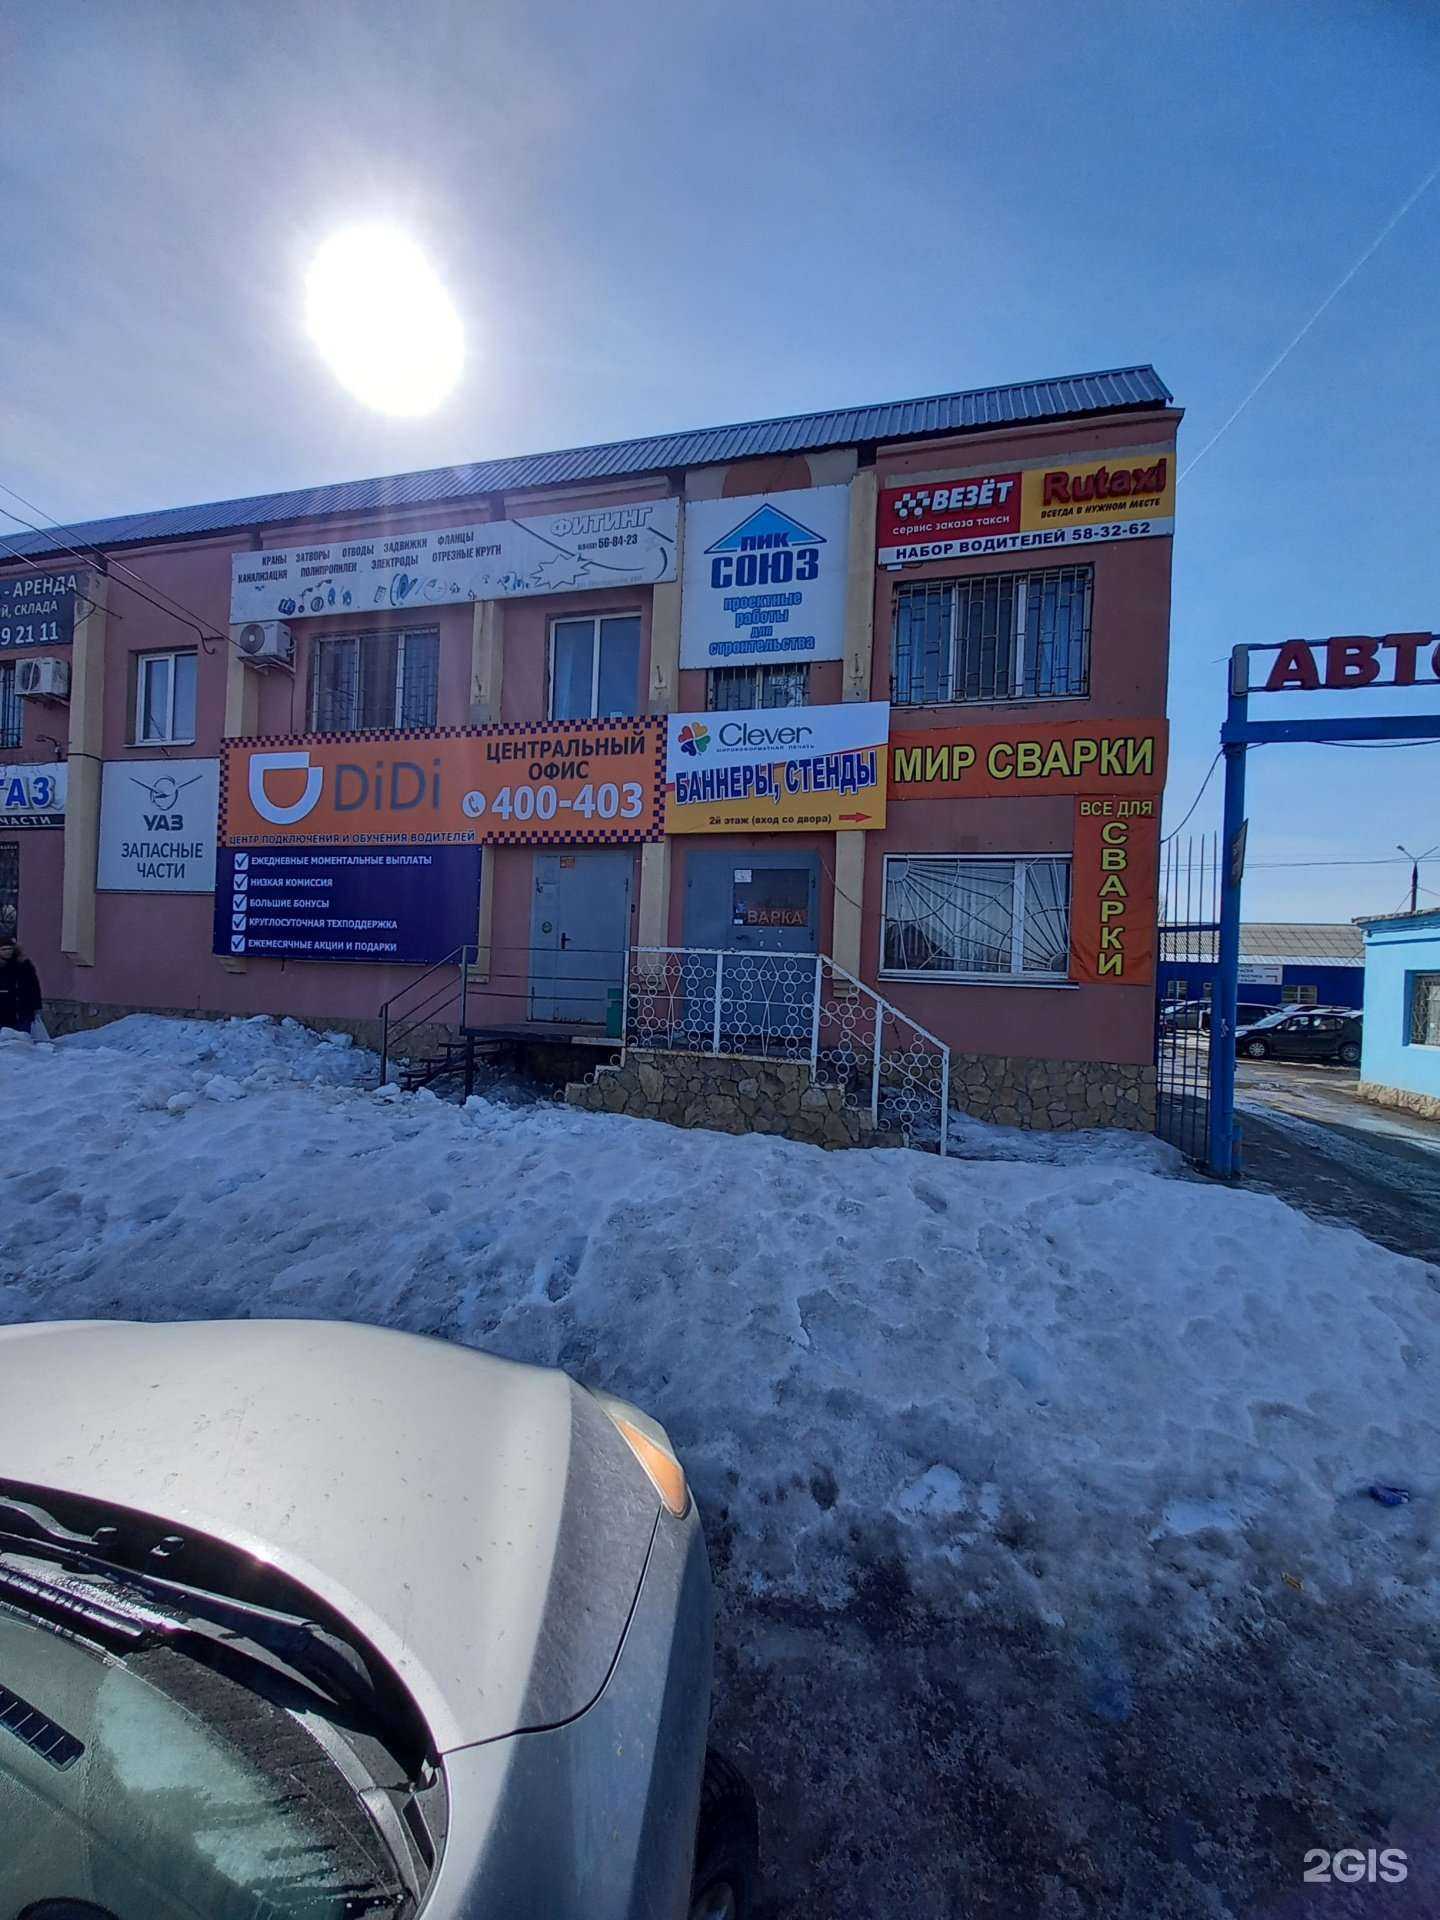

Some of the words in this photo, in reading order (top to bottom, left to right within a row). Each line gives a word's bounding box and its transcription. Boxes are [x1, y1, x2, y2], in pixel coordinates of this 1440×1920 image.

[1042, 458, 1168, 506] Rutaxi
[931, 479, 1014, 511] ВЕЗЁТ
[1041, 506, 1074, 518] ВСЕГДА
[1077, 505, 1083, 514] В
[1085, 500, 1127, 514] НУЖНОМ
[1129, 498, 1161, 510] МЕСТЕ
[551, 507, 654, 537] ФИТИНГ
[892, 520, 933, 535] сервис
[935, 518, 974, 530] заказа
[976, 515, 1010, 528] такси
[261, 554, 287, 566] КРАНЫ
[295, 550, 330, 563] ЗАТВОРЫ
[341, 545, 375, 559] ОТВОДЫ
[383, 538, 428, 553] ЗАДВИЖКИ
[437, 531, 475, 546] ФЛАНЦЫ
[740, 532, 791, 552] ПИК
[895, 543, 954, 560] НАБОР
[959, 529, 1066, 554] ВОДИТЕЛЕЙ
[1071, 522, 1151, 542] 58-32-62
[238, 569, 288, 584] КАНАЛИЗАЦИЯ
[300, 562, 358, 578] ПОЛИПРОПИЛЕН
[371, 555, 419, 570] ЭЛЕКТРОДЫ
[432, 547, 474, 562] ОТРЕЗНЫЕ
[475, 544, 502, 559] КРУГИ
[711, 548, 820, 589] СОЮЗ
[12, 574, 77, 598] АРЕНДА
[14, 601, 58, 616] СКЛАДА
[723, 591, 803, 612] проектные
[735, 608, 789, 628] работы
[15, 625, 34, 644] 21
[39, 621, 59, 641] 11
[750, 625, 774, 638] для
[708, 636, 816, 657] строительства
[1266, 632, 1440, 691] АВТ
[718, 722, 813, 747] Clever
[486, 730, 646, 764] ЦЕНТРАЛЬНЫЙ
[894, 745, 976, 783] МИР
[987, 737, 1155, 780] СВАРКИ
[528, 761, 590, 781] ОФИС
[675, 762, 781, 806] БАННЕРЫ,
[784, 751, 878, 797] СТЕНДЫ
[333, 758, 441, 811] DiDi
[490, 782, 645, 820] 400-403
[1080, 801, 1113, 816] ВСЕ
[1116, 800, 1153, 818] ДЛЯ
[143, 814, 184, 831] УАЗ
[708, 815, 721, 825] 2й
[724, 816, 751, 825] этаж
[752, 815, 779, 826] (вход
[782, 816, 795, 825] со
[796, 814, 832, 826] двора)
[229, 835, 259, 845] ЦЕНТР
[261, 834, 340, 844] ПОДКЛЮЧЕНИЯ
[342, 834, 350, 842] И
[352, 833, 408, 843] ОБУЧЕНИЯ
[410, 830, 476, 842] ВОДИТЕЛЕЙ
[121, 842, 204, 859] ЗАПАСНЫЕ
[251, 856, 309, 866] ЕЖЕДНЕВНЫЕ
[310, 856, 385, 866] МОМЕНТАЛЬНЫЕ
[385, 855, 432, 865] ВЫПЛАТЫ
[136, 863, 186, 879] ЧАСТИ
[250, 878, 284, 887] НИЗКАЯ
[285, 878, 333, 887] КОМИССИЯ
[249, 899, 292, 908] БОЛЬШИЕ
[293, 899, 330, 908] БОНУСЫ
[1098, 822, 1128, 976] СВАРКИ
[249, 918, 325, 928] КРУГЛОСУТОЧНАЯ
[326, 919, 398, 930] ТЕХПОДДЕРЖКА
[248, 939, 313, 949] ЕЖЕМЕСЯЧНЫЕ
[313, 940, 345, 951] АКЦИИ
[346, 941, 353, 950] И
[354, 941, 397, 952] ПОДАРКИ
